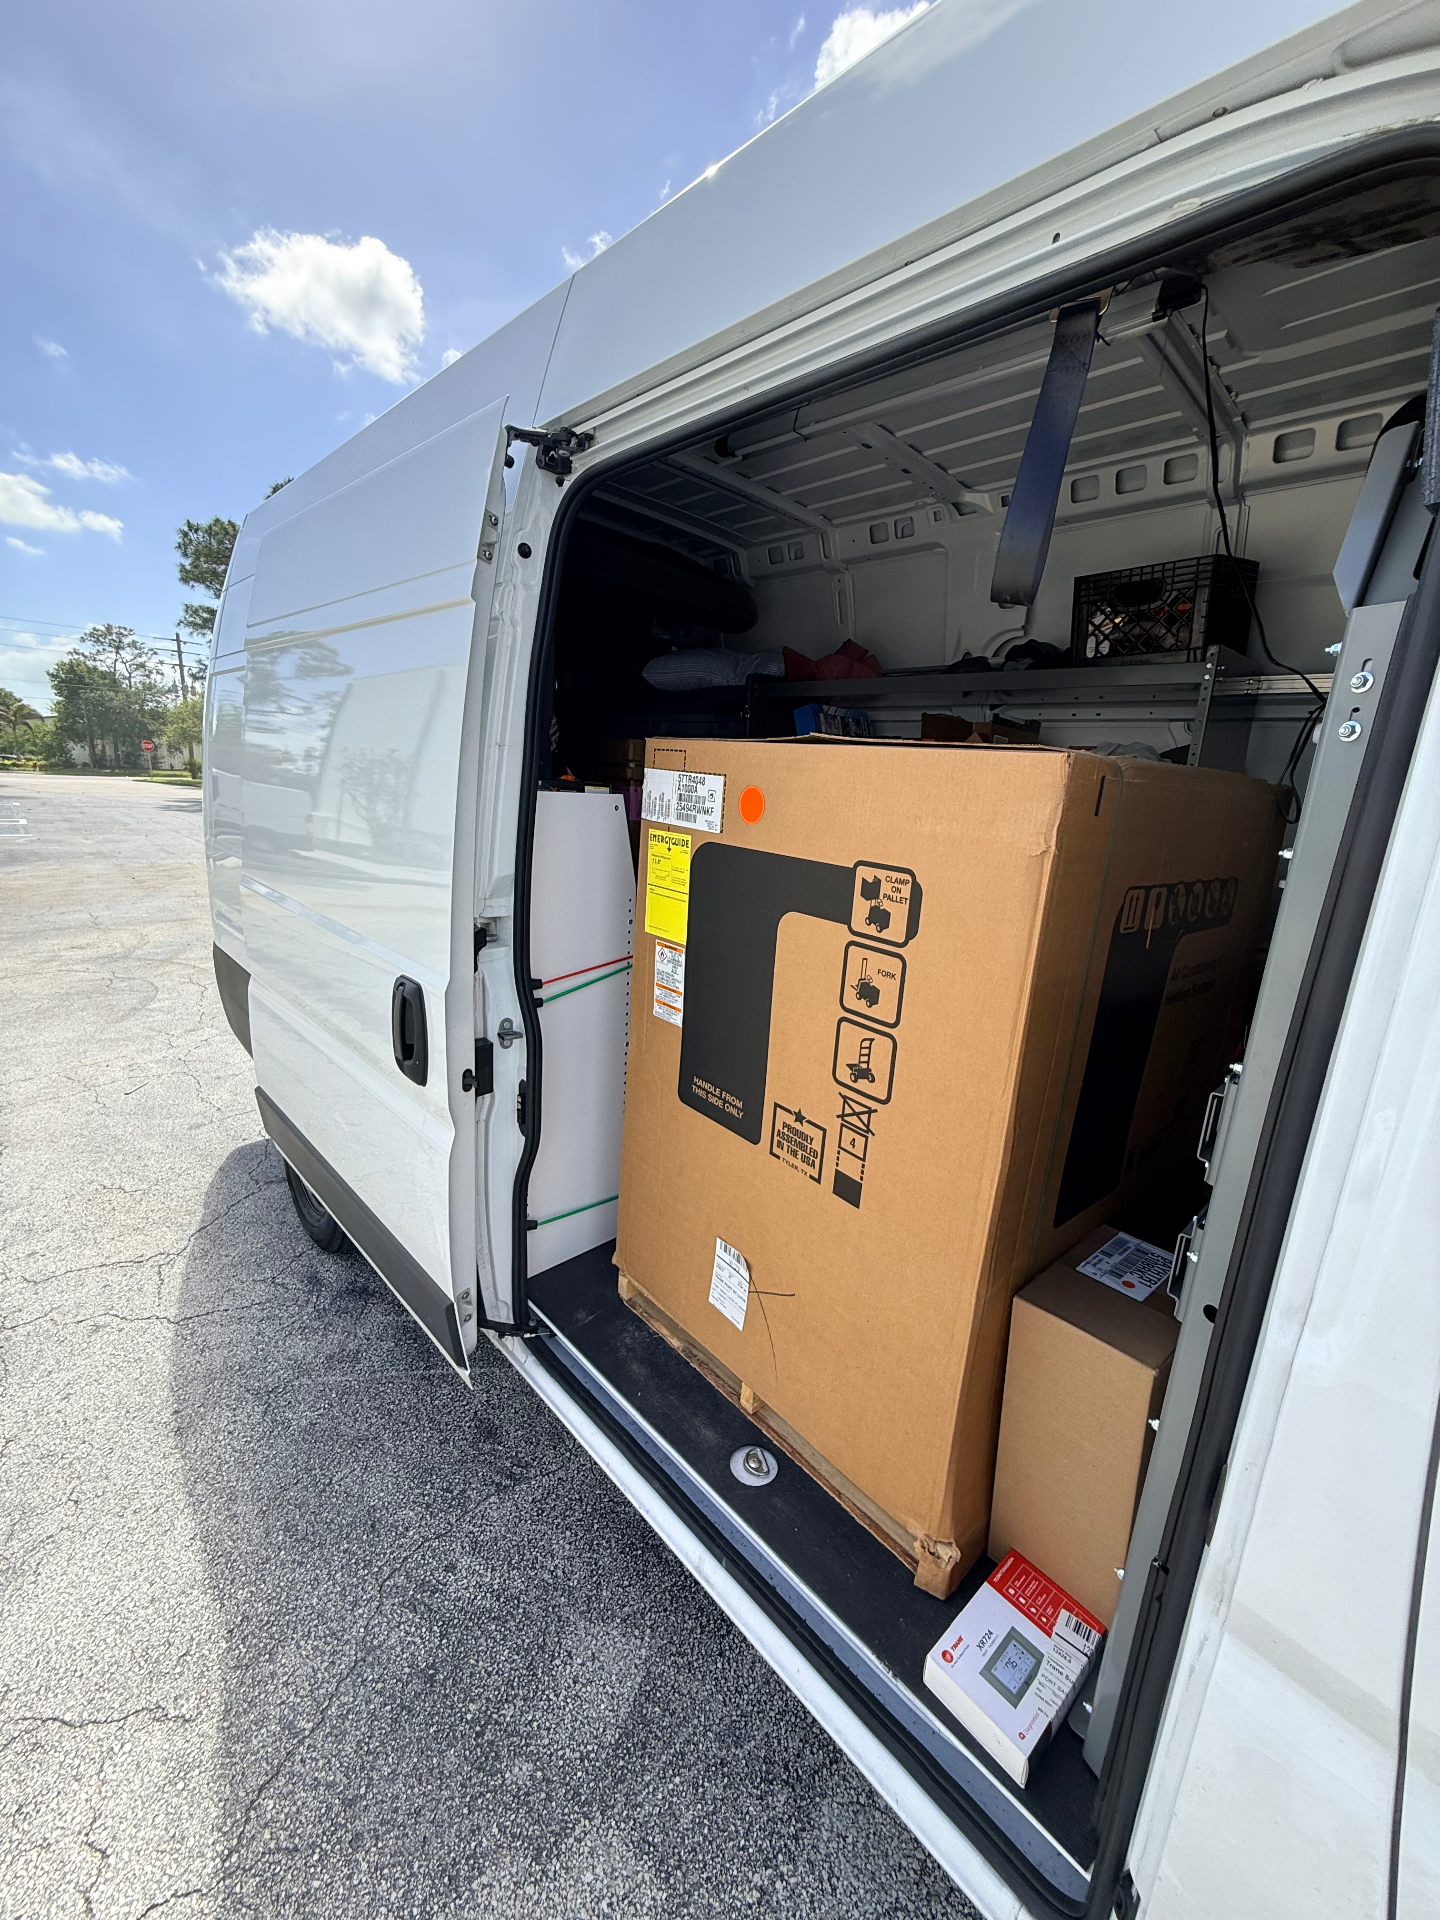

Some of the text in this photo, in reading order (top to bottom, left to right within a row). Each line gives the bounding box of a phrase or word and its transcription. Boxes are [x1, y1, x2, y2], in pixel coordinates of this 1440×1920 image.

[885, 875, 910, 886] CLAMP
[890, 886, 902, 894] ON
[882, 893, 908, 905] PALLET
[877, 969, 897, 980] FORK
[693, 1075, 743, 1109] HANDLE FROM
[691, 1084, 744, 1119] THIS SIDE ONLY
[782, 1120, 814, 1146] PROUDLY
[776, 1128, 818, 1160] ASSEMBLED
[849, 1137, 856, 1149] 4
[776, 1138, 816, 1170] IN THE USA
[781, 1157, 808, 1177] TYLER, TX
[950, 1635, 964, 1652] TRANE
[975, 1629, 994, 1652] XR724
[1046, 1659, 1064, 1676] Trane
[1041, 1673, 1057, 1688] PORT
